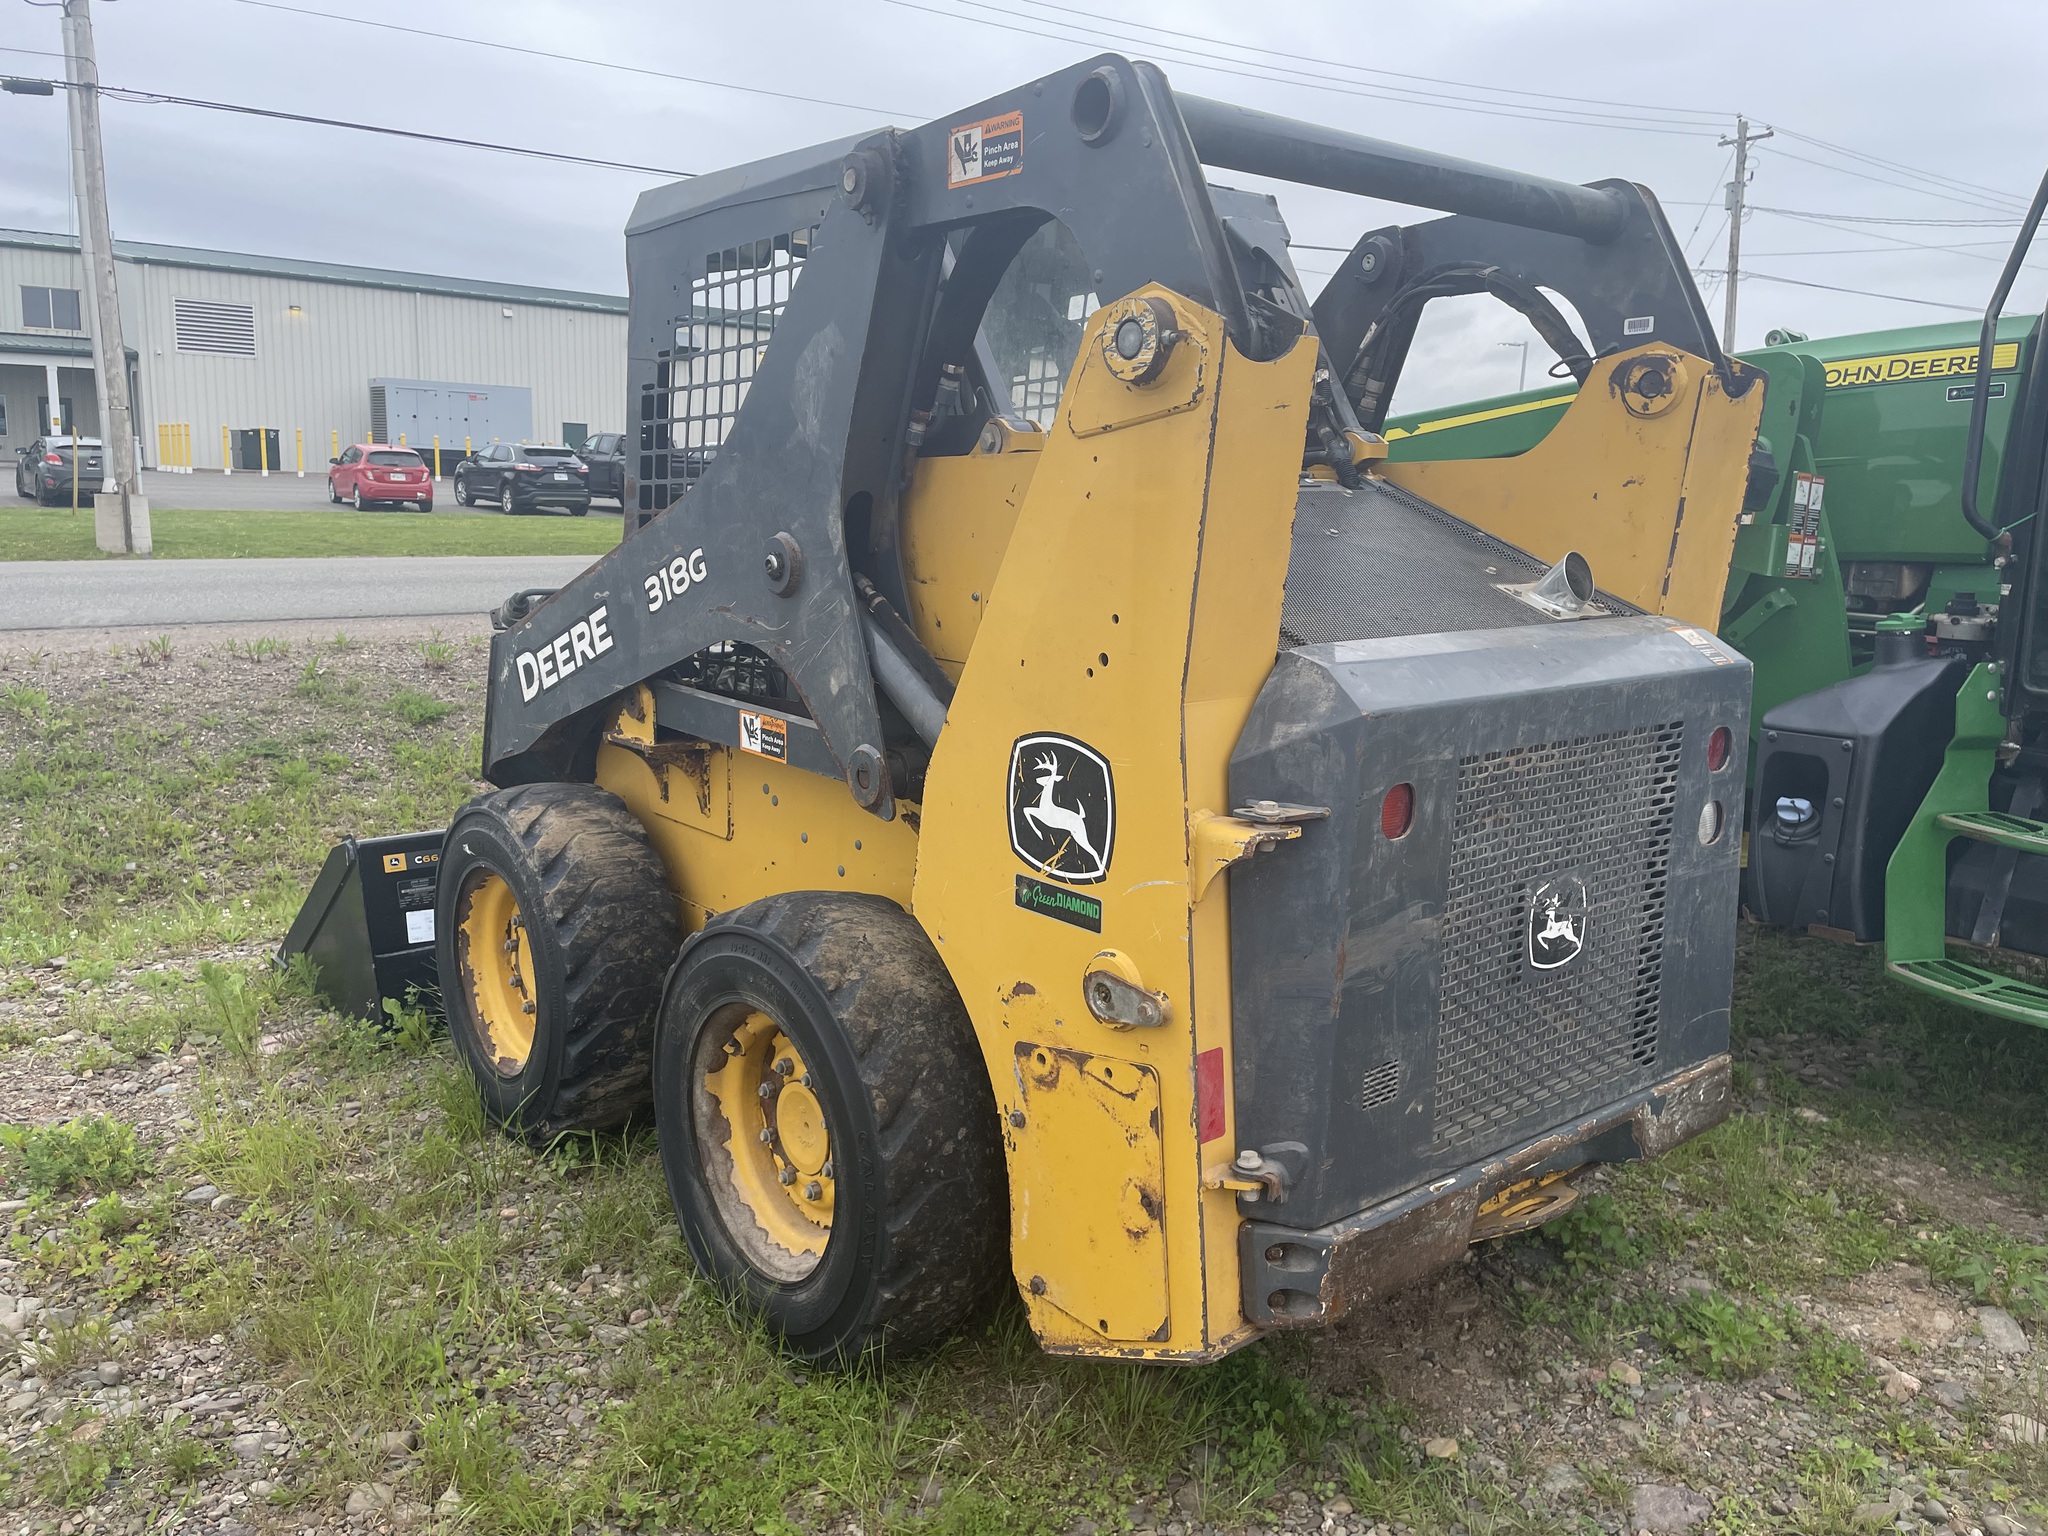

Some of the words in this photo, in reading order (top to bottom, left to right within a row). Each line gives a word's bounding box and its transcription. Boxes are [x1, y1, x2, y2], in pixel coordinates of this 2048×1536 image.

[990, 117, 1020, 131] WARNING
[984, 144, 1002, 155] Pinch
[1003, 141, 1019, 151] Area
[984, 159, 998, 167] Keep
[999, 155, 1014, 164] Away
[1825, 364, 1883, 384] OHN
[644, 547, 707, 612] 318G
[515, 605, 614, 703] DEERE
[762, 734, 773, 743] Pinch
[773, 737, 784, 746] Area
[762, 743, 771, 752] Keep
[1032, 886, 1057, 908] Green
[1056, 892, 1099, 920] DIAMOND
